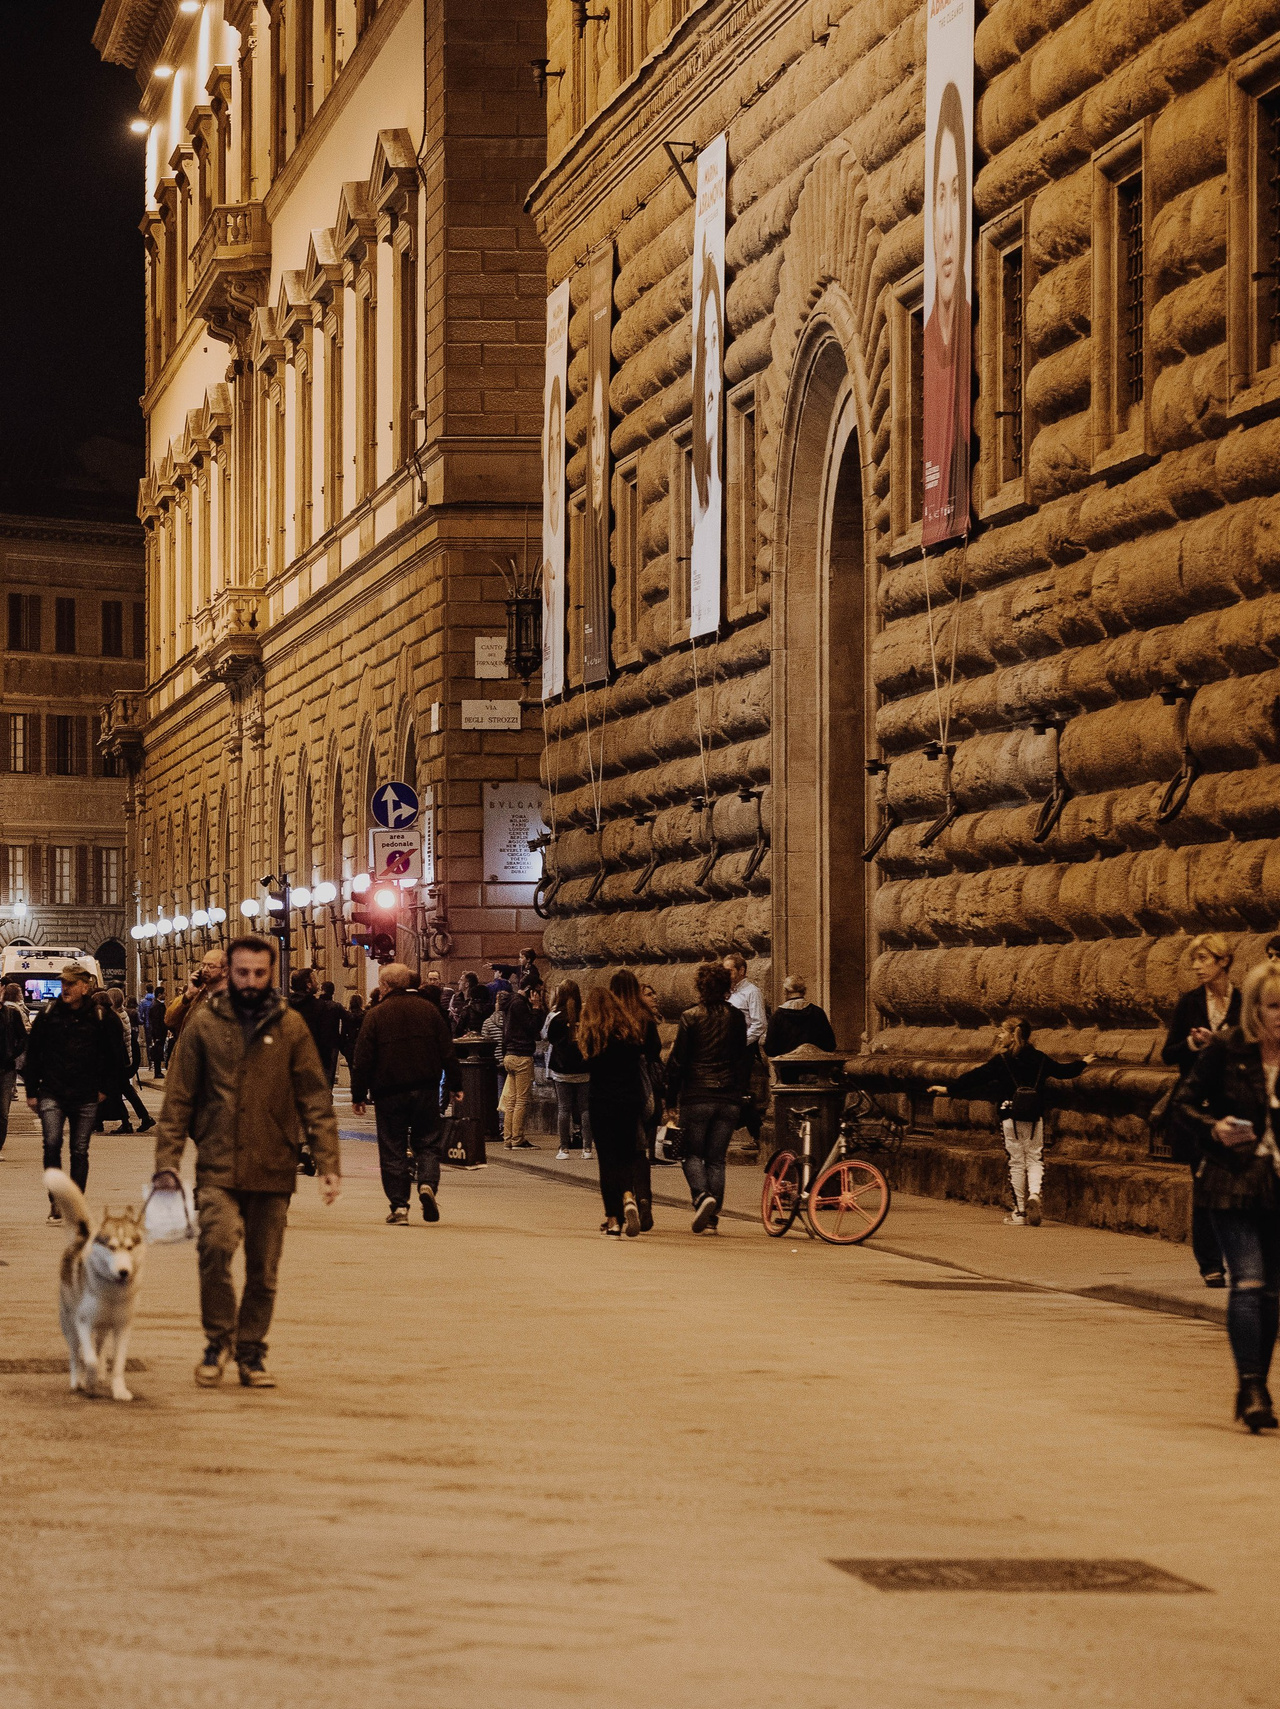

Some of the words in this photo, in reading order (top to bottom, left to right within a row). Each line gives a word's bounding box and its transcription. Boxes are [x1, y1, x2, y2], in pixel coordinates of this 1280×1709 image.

[464, 716, 484, 724] DEGLI
[487, 716, 519, 724] STROZZI
[489, 801, 543, 809] BVLGAR
[381, 840, 414, 848] pedonale
